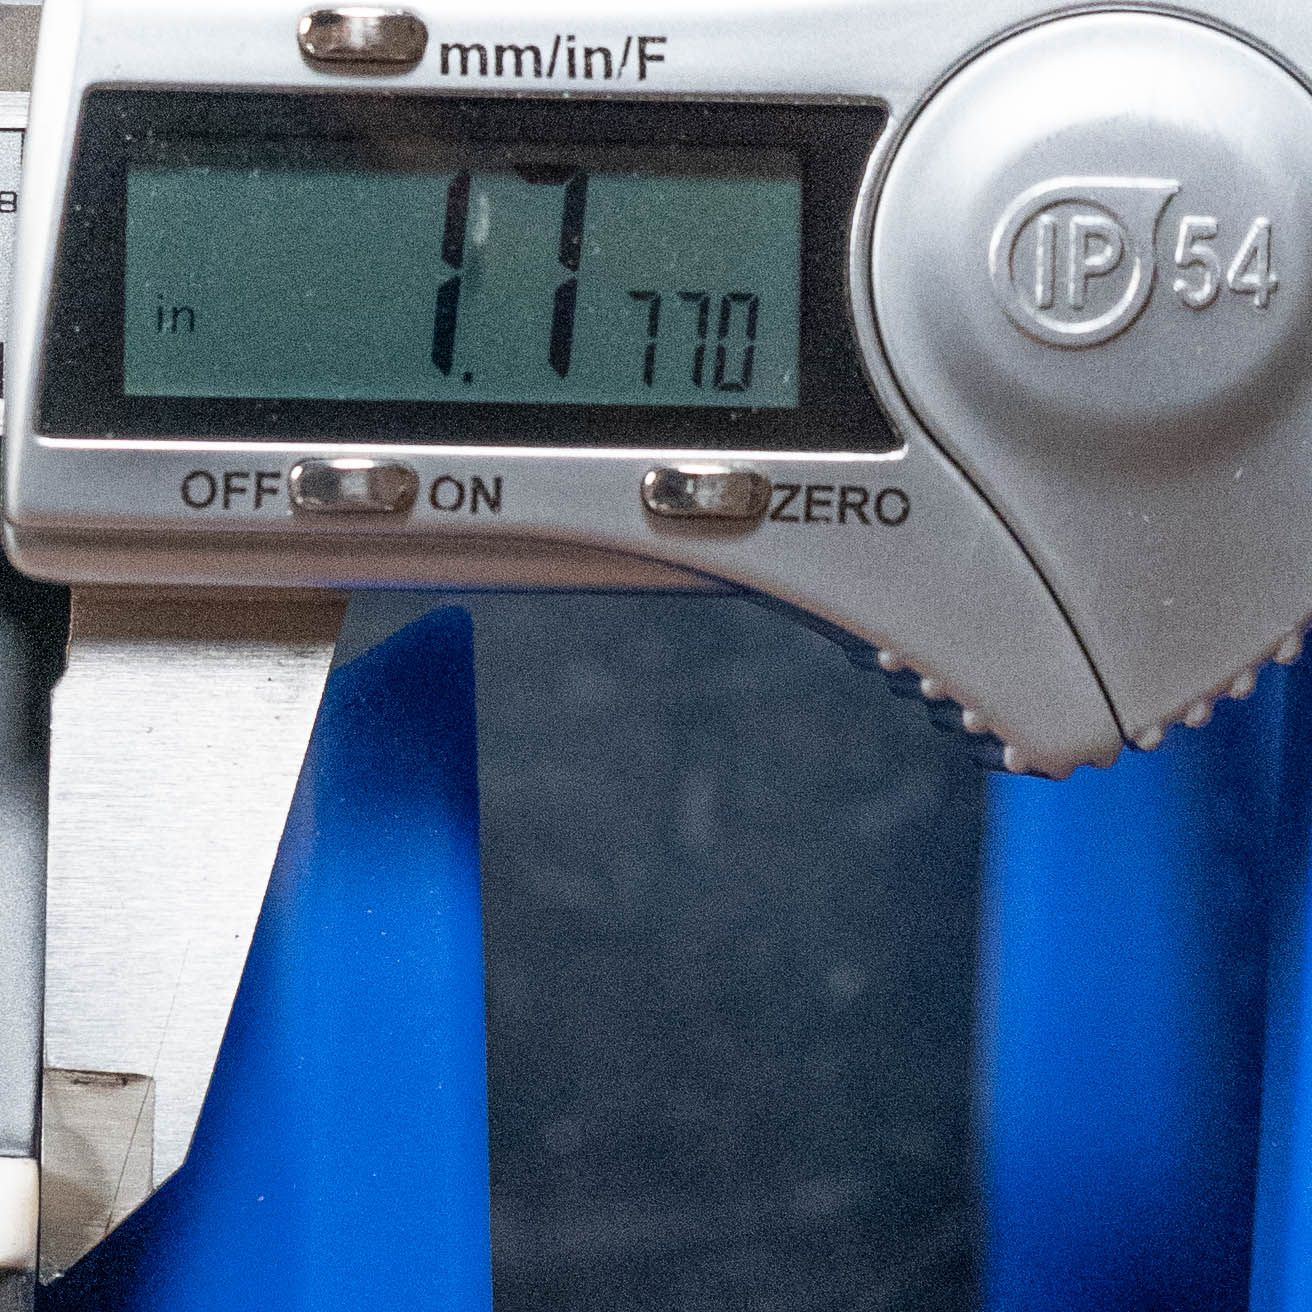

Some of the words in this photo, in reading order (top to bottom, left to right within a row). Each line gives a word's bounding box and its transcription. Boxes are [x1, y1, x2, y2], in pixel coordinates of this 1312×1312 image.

[440, 34, 668, 81] mm/in/F
[1034, 213, 1126, 310] IP
[1173, 214, 1278, 311] 54
[156, 293, 196, 333] in
[180, 469, 282, 509] OFF
[429, 474, 504, 514] ON
[769, 482, 911, 527] ZERO
